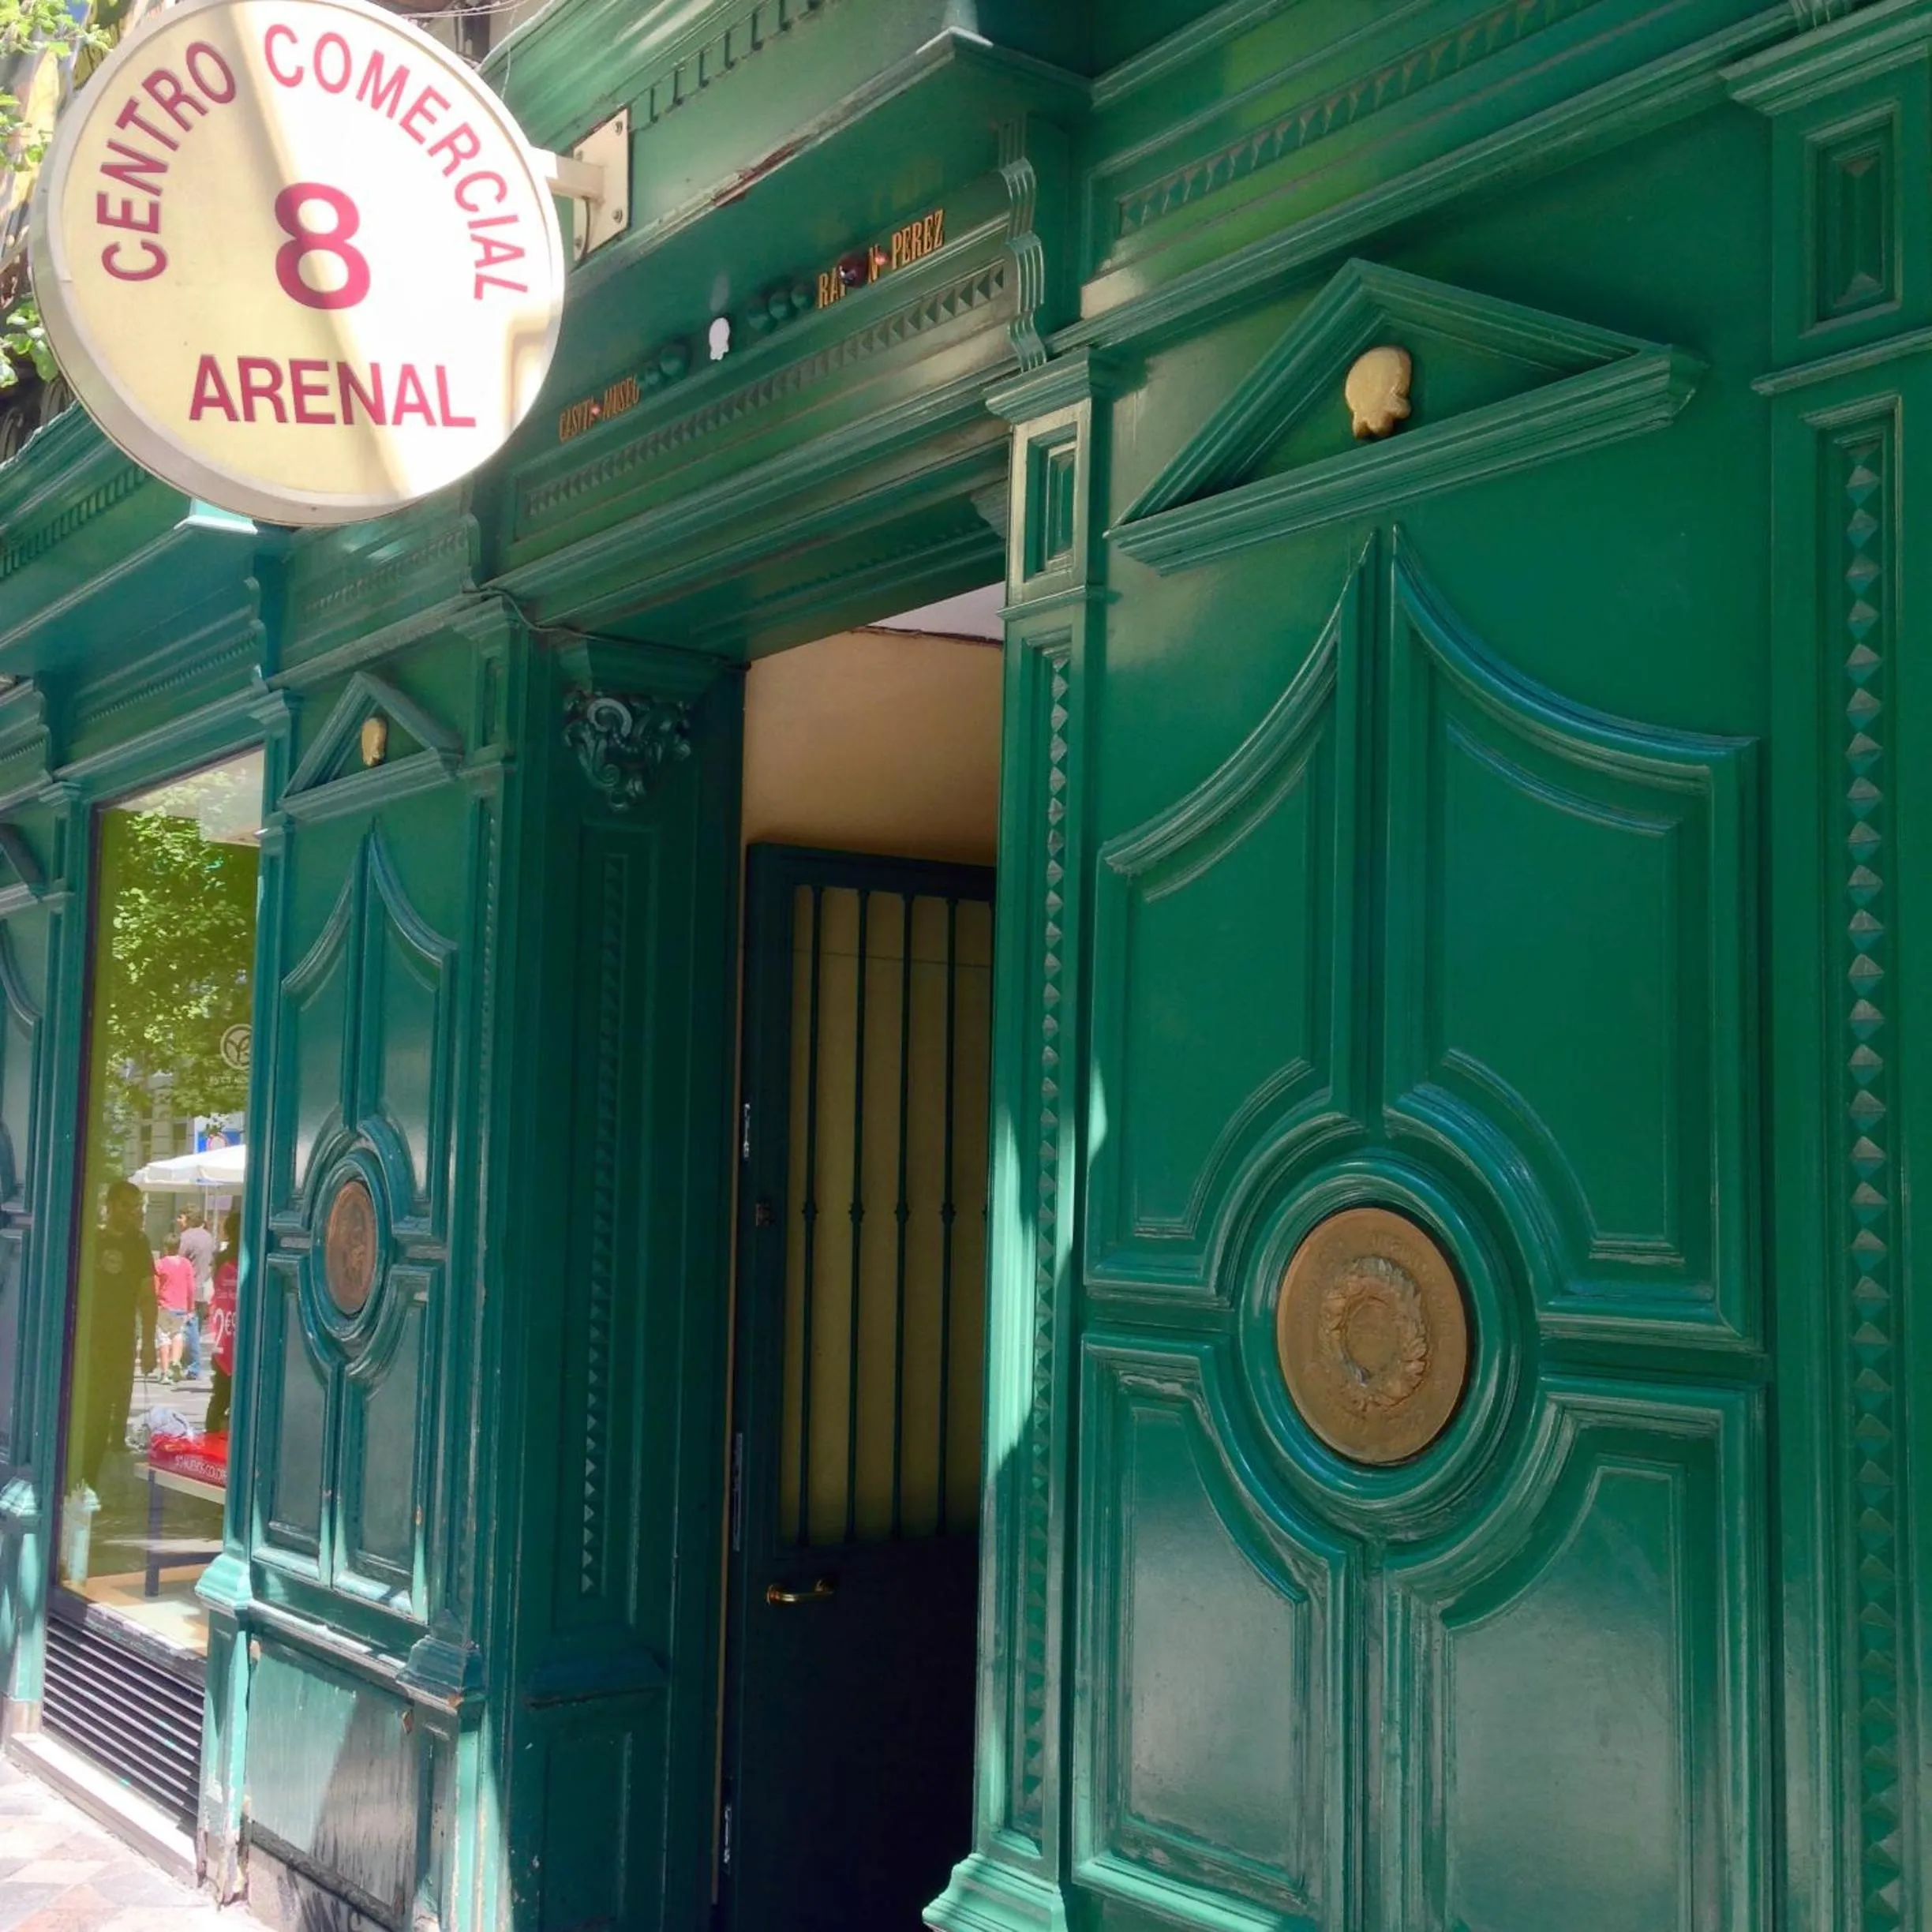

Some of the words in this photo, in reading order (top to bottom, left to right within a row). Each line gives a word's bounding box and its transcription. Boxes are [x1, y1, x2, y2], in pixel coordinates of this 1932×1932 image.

[96, 41, 236, 282] CENTRO
[264, 24, 528, 300] COMERCIAL
[275, 182, 370, 310] 8
[891, 208, 944, 270] PEREZ
[189, 354, 476, 428] ARENAL
